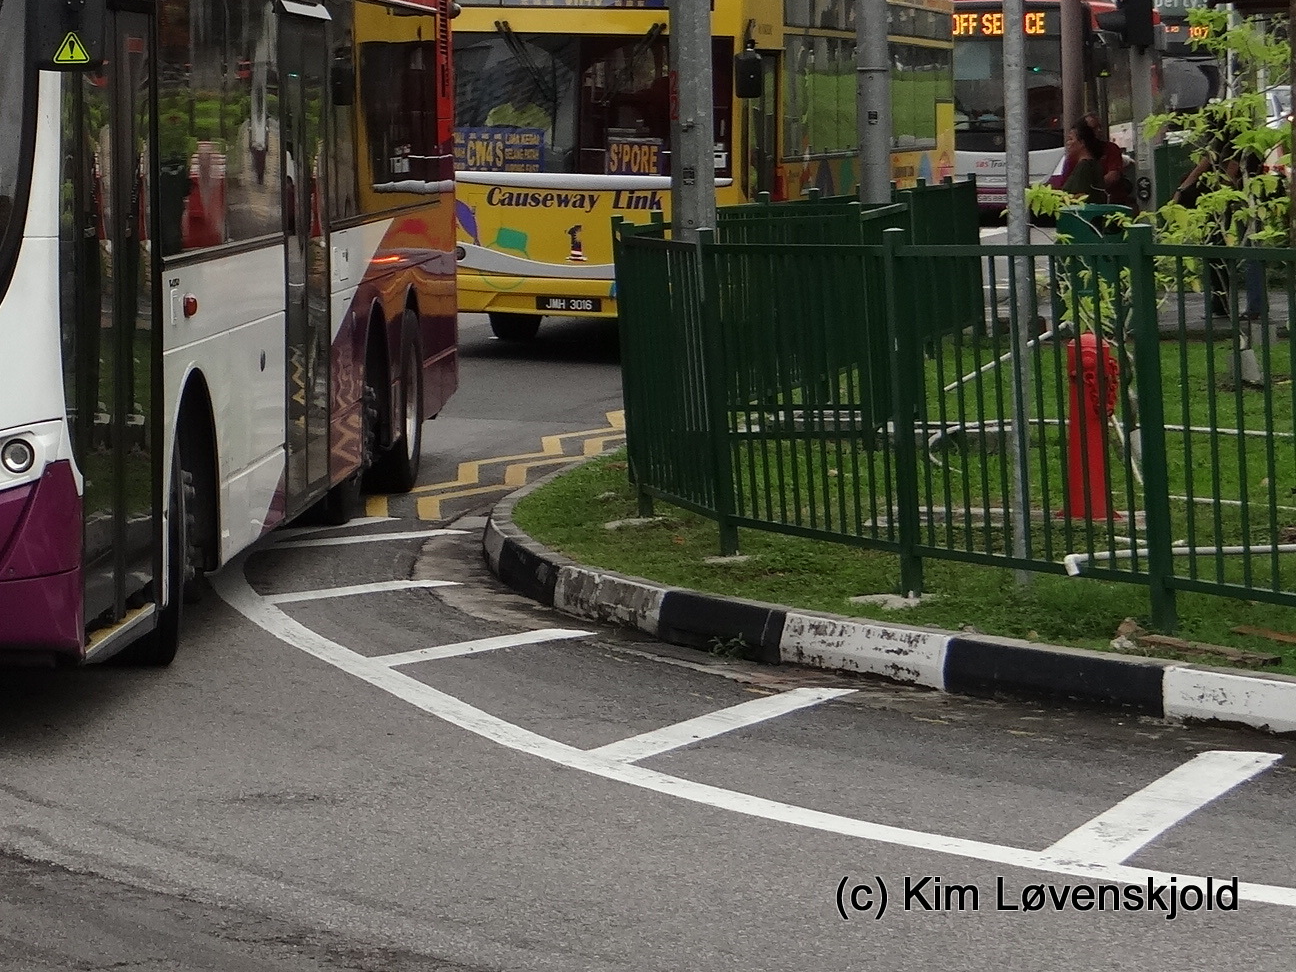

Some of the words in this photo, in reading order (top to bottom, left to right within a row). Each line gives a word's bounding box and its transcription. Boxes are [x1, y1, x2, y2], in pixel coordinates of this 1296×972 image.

[981, 12, 1046, 35] SECE
[609, 143, 659, 174] S'PORE
[487, 186, 602, 213] Causeway
[611, 189, 664, 211] Link
[545, 298, 567, 310] JMH
[569, 299, 594, 311] 3016
